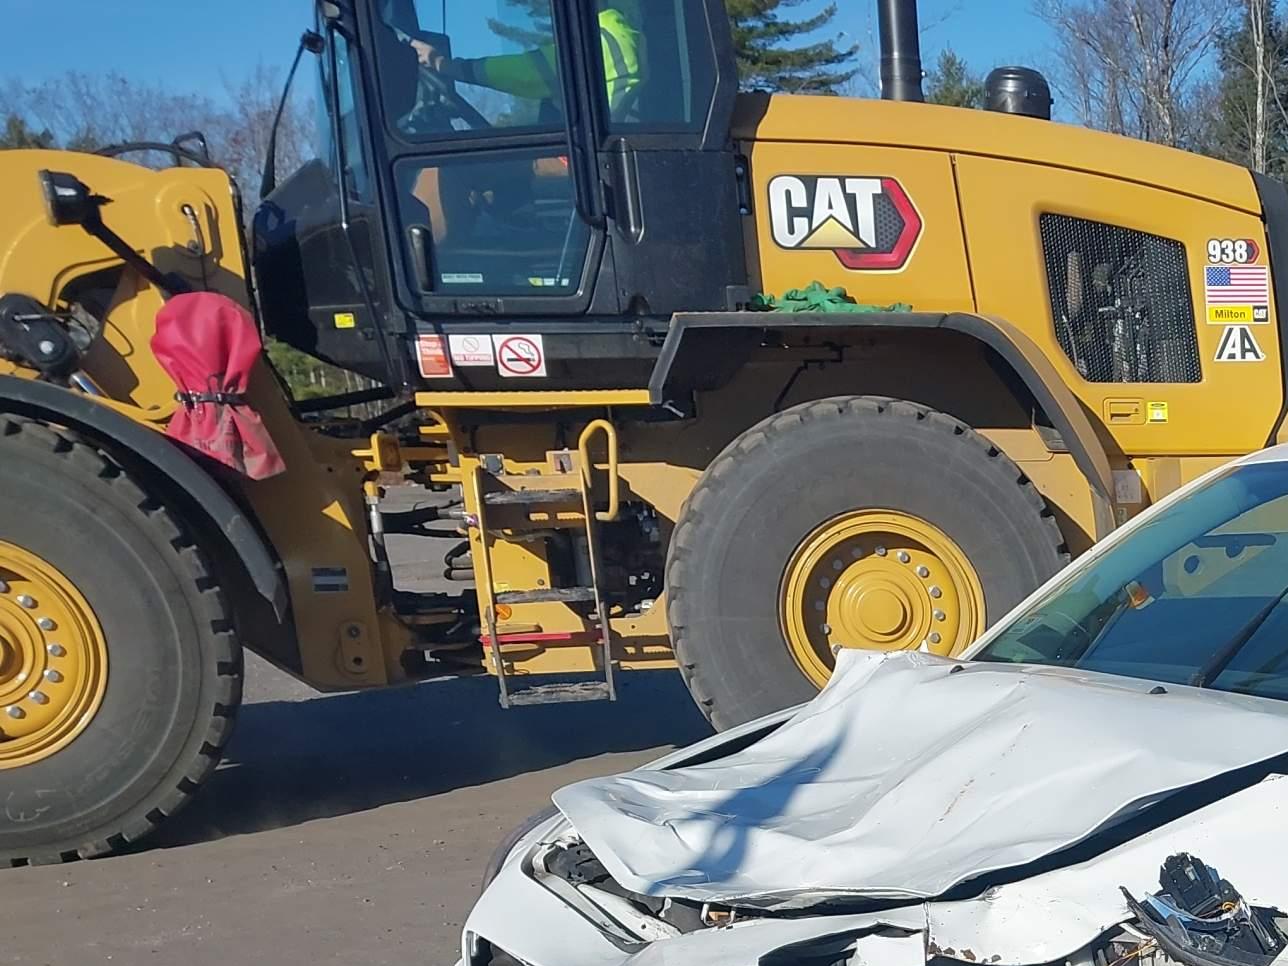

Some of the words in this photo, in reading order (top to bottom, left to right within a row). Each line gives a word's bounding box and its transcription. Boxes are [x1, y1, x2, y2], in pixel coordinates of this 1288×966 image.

[769, 175, 883, 248] CAT
[1207, 239, 1249, 264] 938
[1214, 308, 1246, 319] Milton
[1253, 307, 1268, 319] CAT
